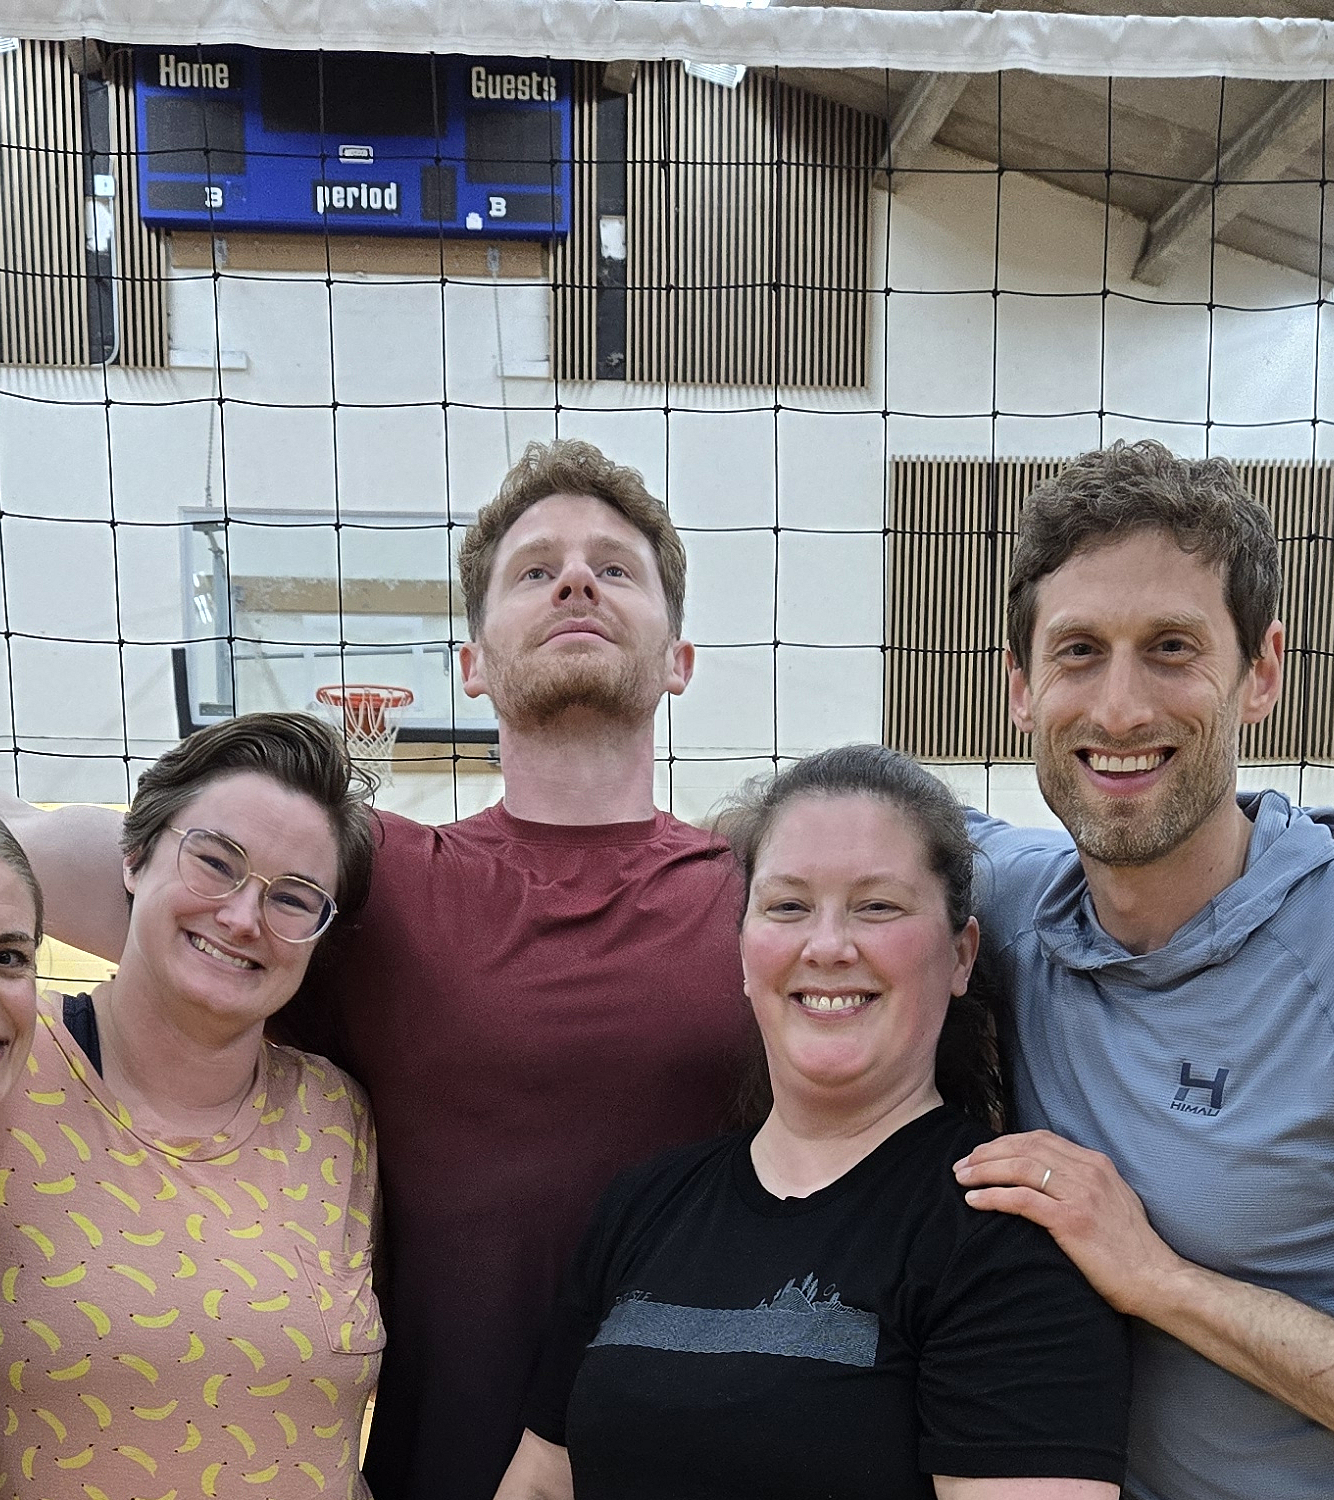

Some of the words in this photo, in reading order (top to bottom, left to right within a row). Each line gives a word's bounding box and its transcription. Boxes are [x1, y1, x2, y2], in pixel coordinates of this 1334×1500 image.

[159, 54, 229, 89] Home
[471, 66, 557, 102] Guests
[316, 182, 398, 214] period
